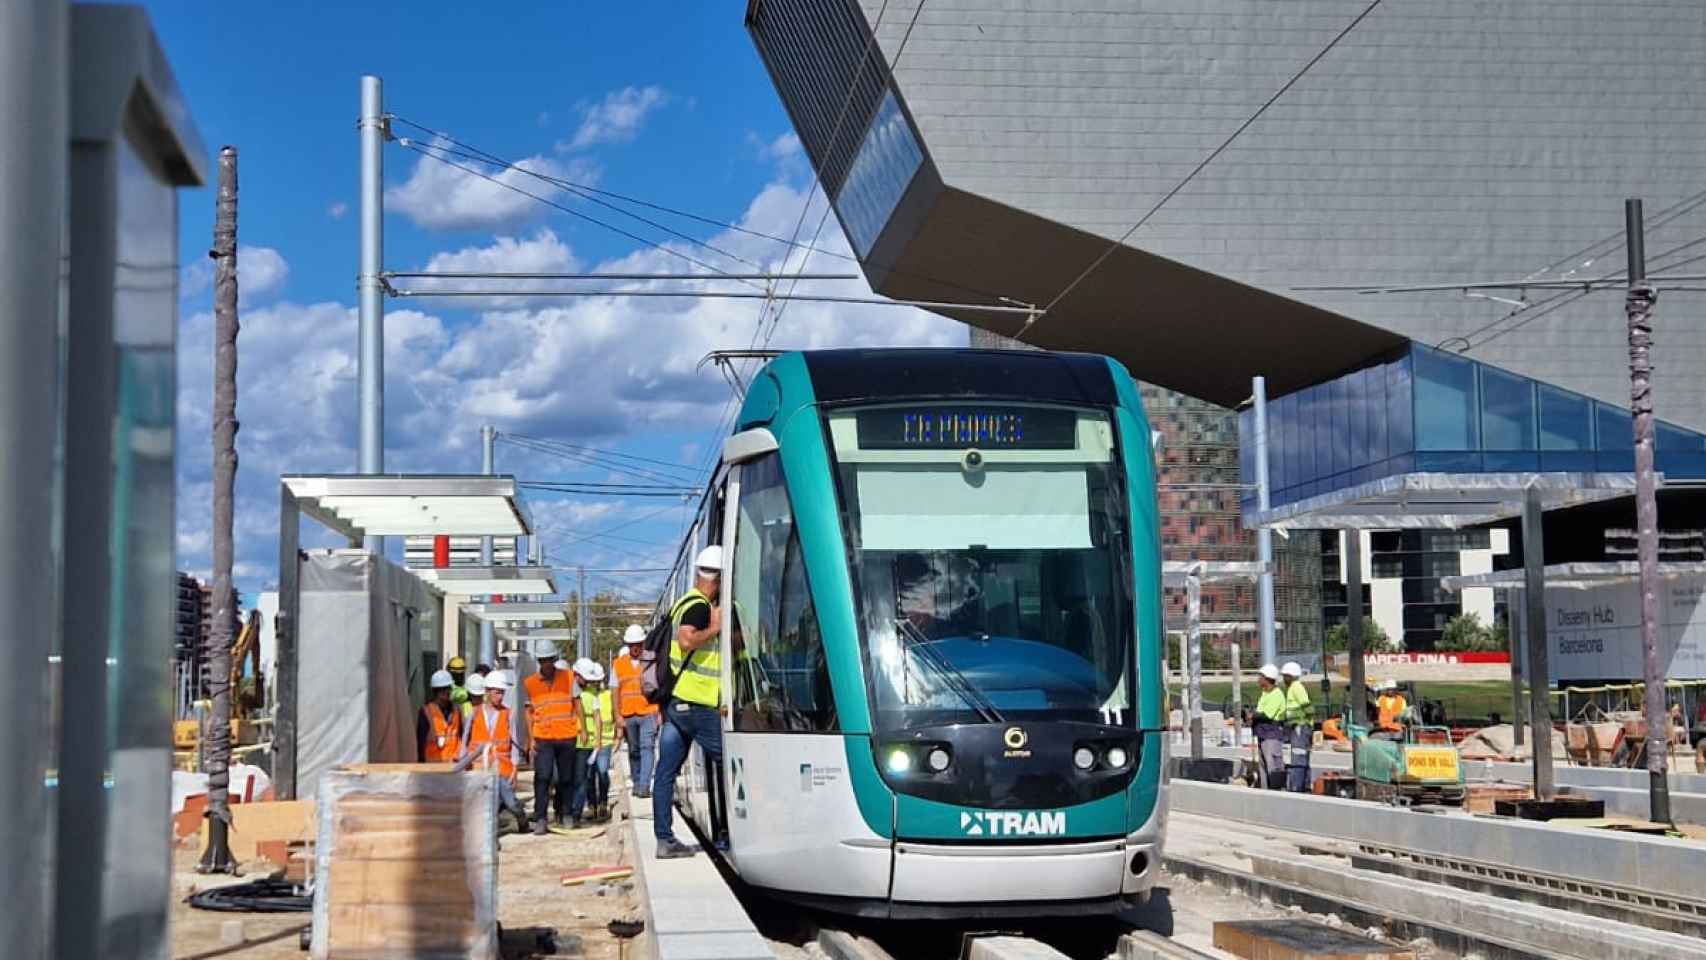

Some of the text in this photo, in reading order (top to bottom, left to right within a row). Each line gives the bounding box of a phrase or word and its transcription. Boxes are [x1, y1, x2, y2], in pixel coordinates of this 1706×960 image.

[1557, 604, 1615, 628] Disseny Hub
[1559, 635, 1604, 655] Barcelona
[1363, 653, 1446, 665] ARCELONA
[985, 811, 1066, 836] TRAM
